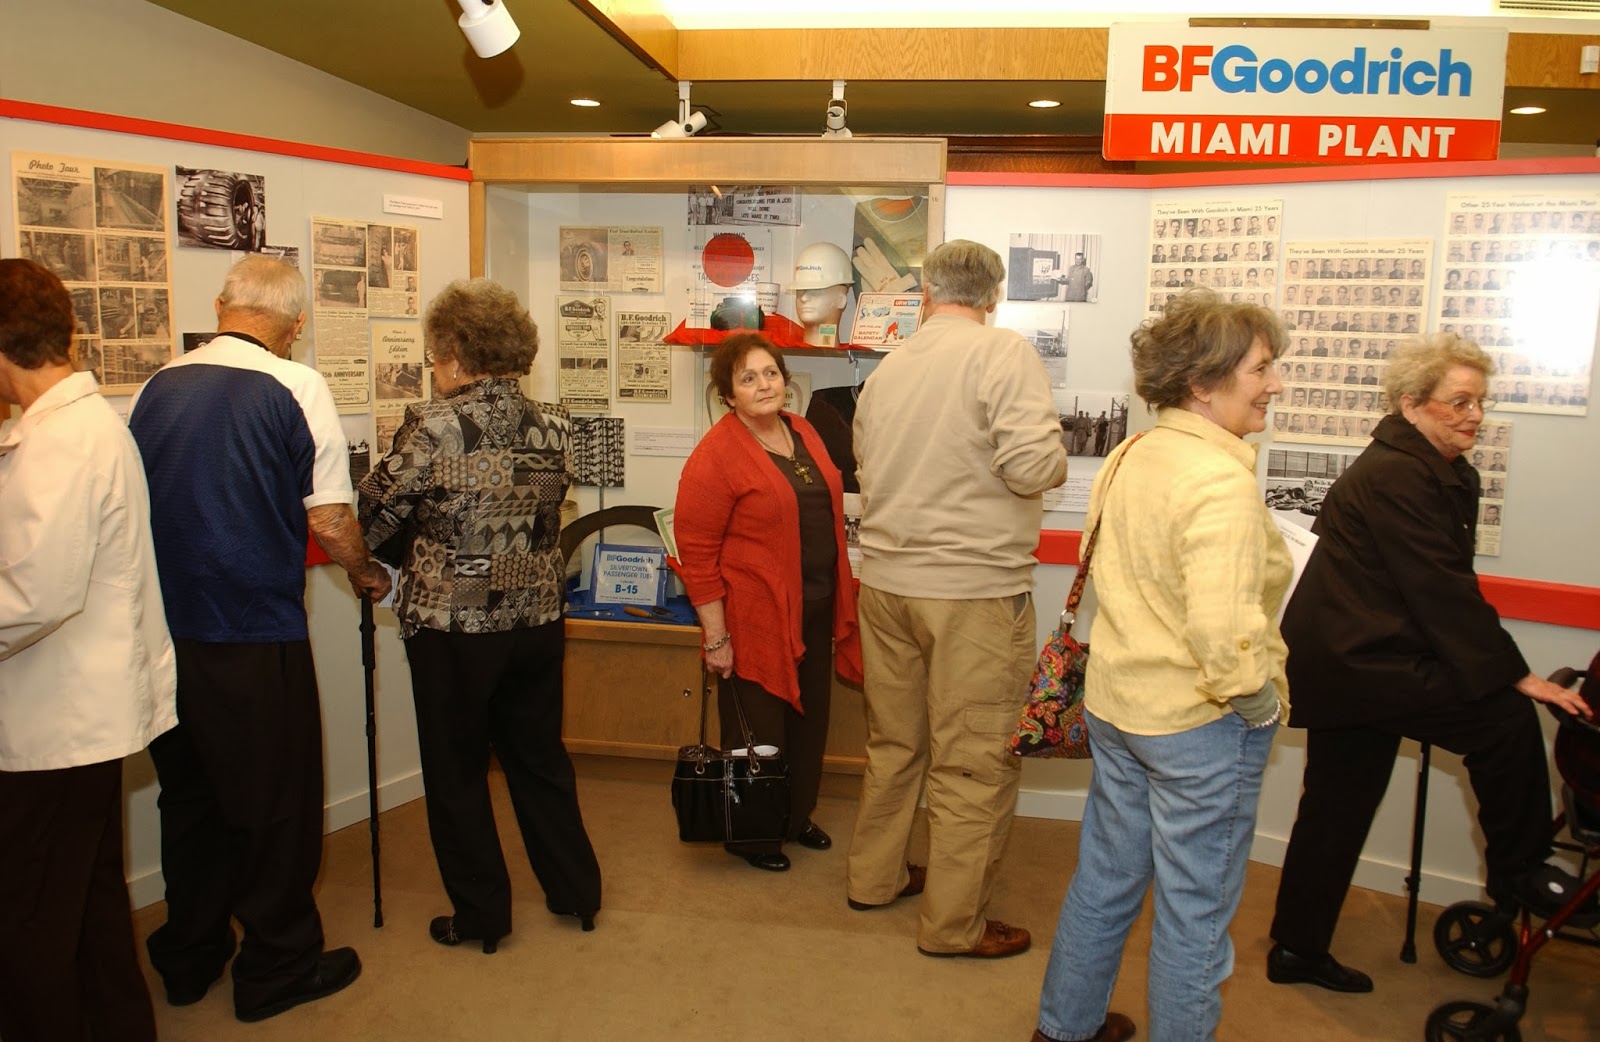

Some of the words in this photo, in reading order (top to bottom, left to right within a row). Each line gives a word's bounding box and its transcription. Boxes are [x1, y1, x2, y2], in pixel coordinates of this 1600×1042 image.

[1142, 44, 1473, 97] BFGoodrich
[1150, 121, 1291, 156] MIAMI
[1318, 124, 1456, 159] PLANT
[28, 159, 54, 170] Photo
[59, 162, 80, 174] Tour
[382, 335, 416, 344] Anniversary
[388, 344, 409, 354] Edition
[333, 370, 365, 378] ANNIVERSARY
[606, 554, 654, 565] BFGoodrih
[610, 564, 648, 573] SILVERTOWN
[603, 570, 639, 579] PASSENGER
[614, 583, 638, 595] B-15
